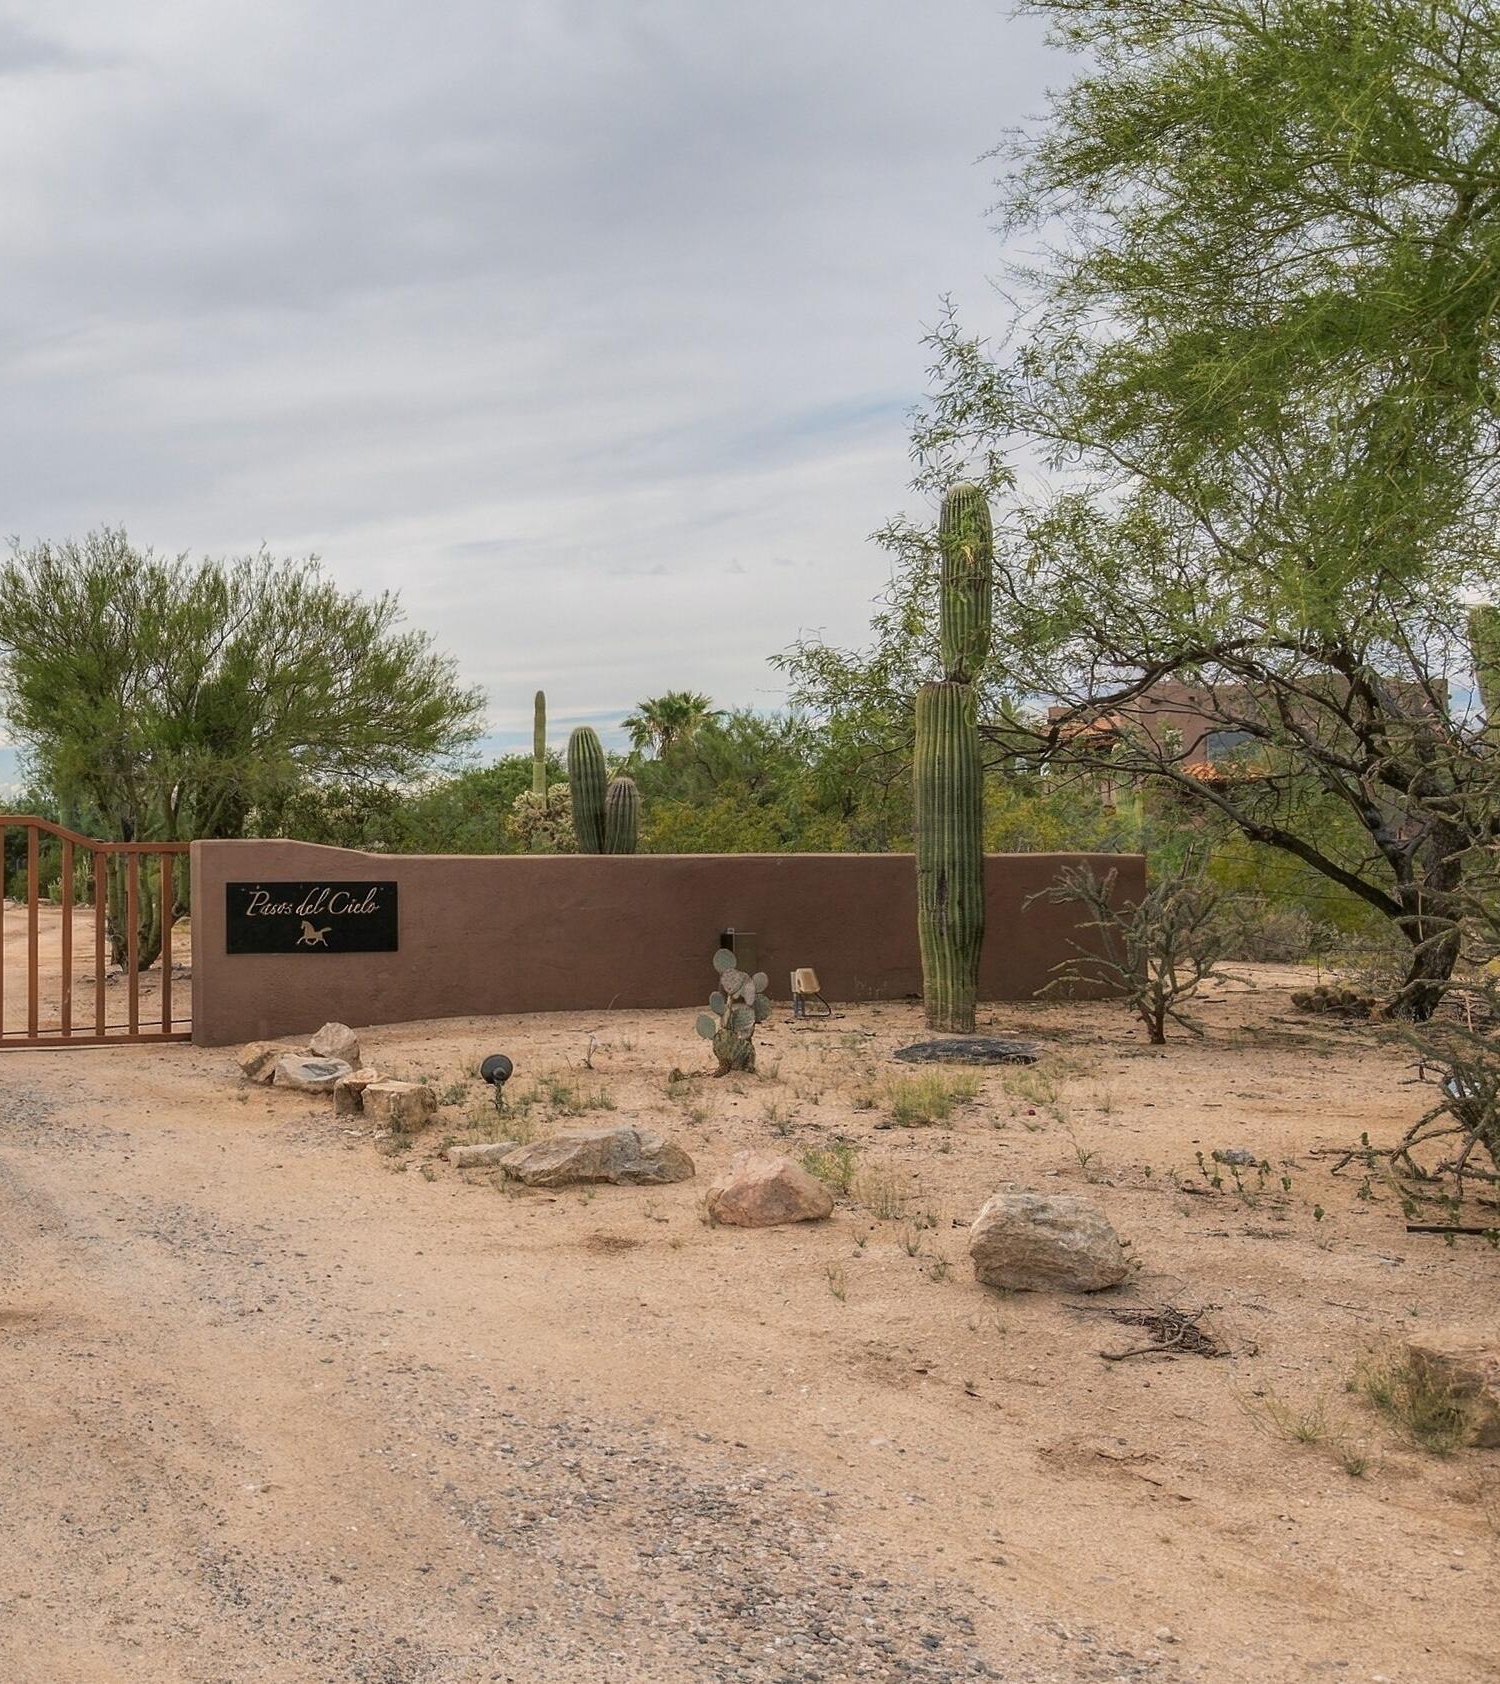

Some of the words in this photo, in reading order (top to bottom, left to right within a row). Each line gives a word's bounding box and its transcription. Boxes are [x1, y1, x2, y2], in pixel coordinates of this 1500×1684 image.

[246, 890, 292, 916] Pasos
[296, 887, 331, 916] del
[328, 887, 380, 915] Cielo
